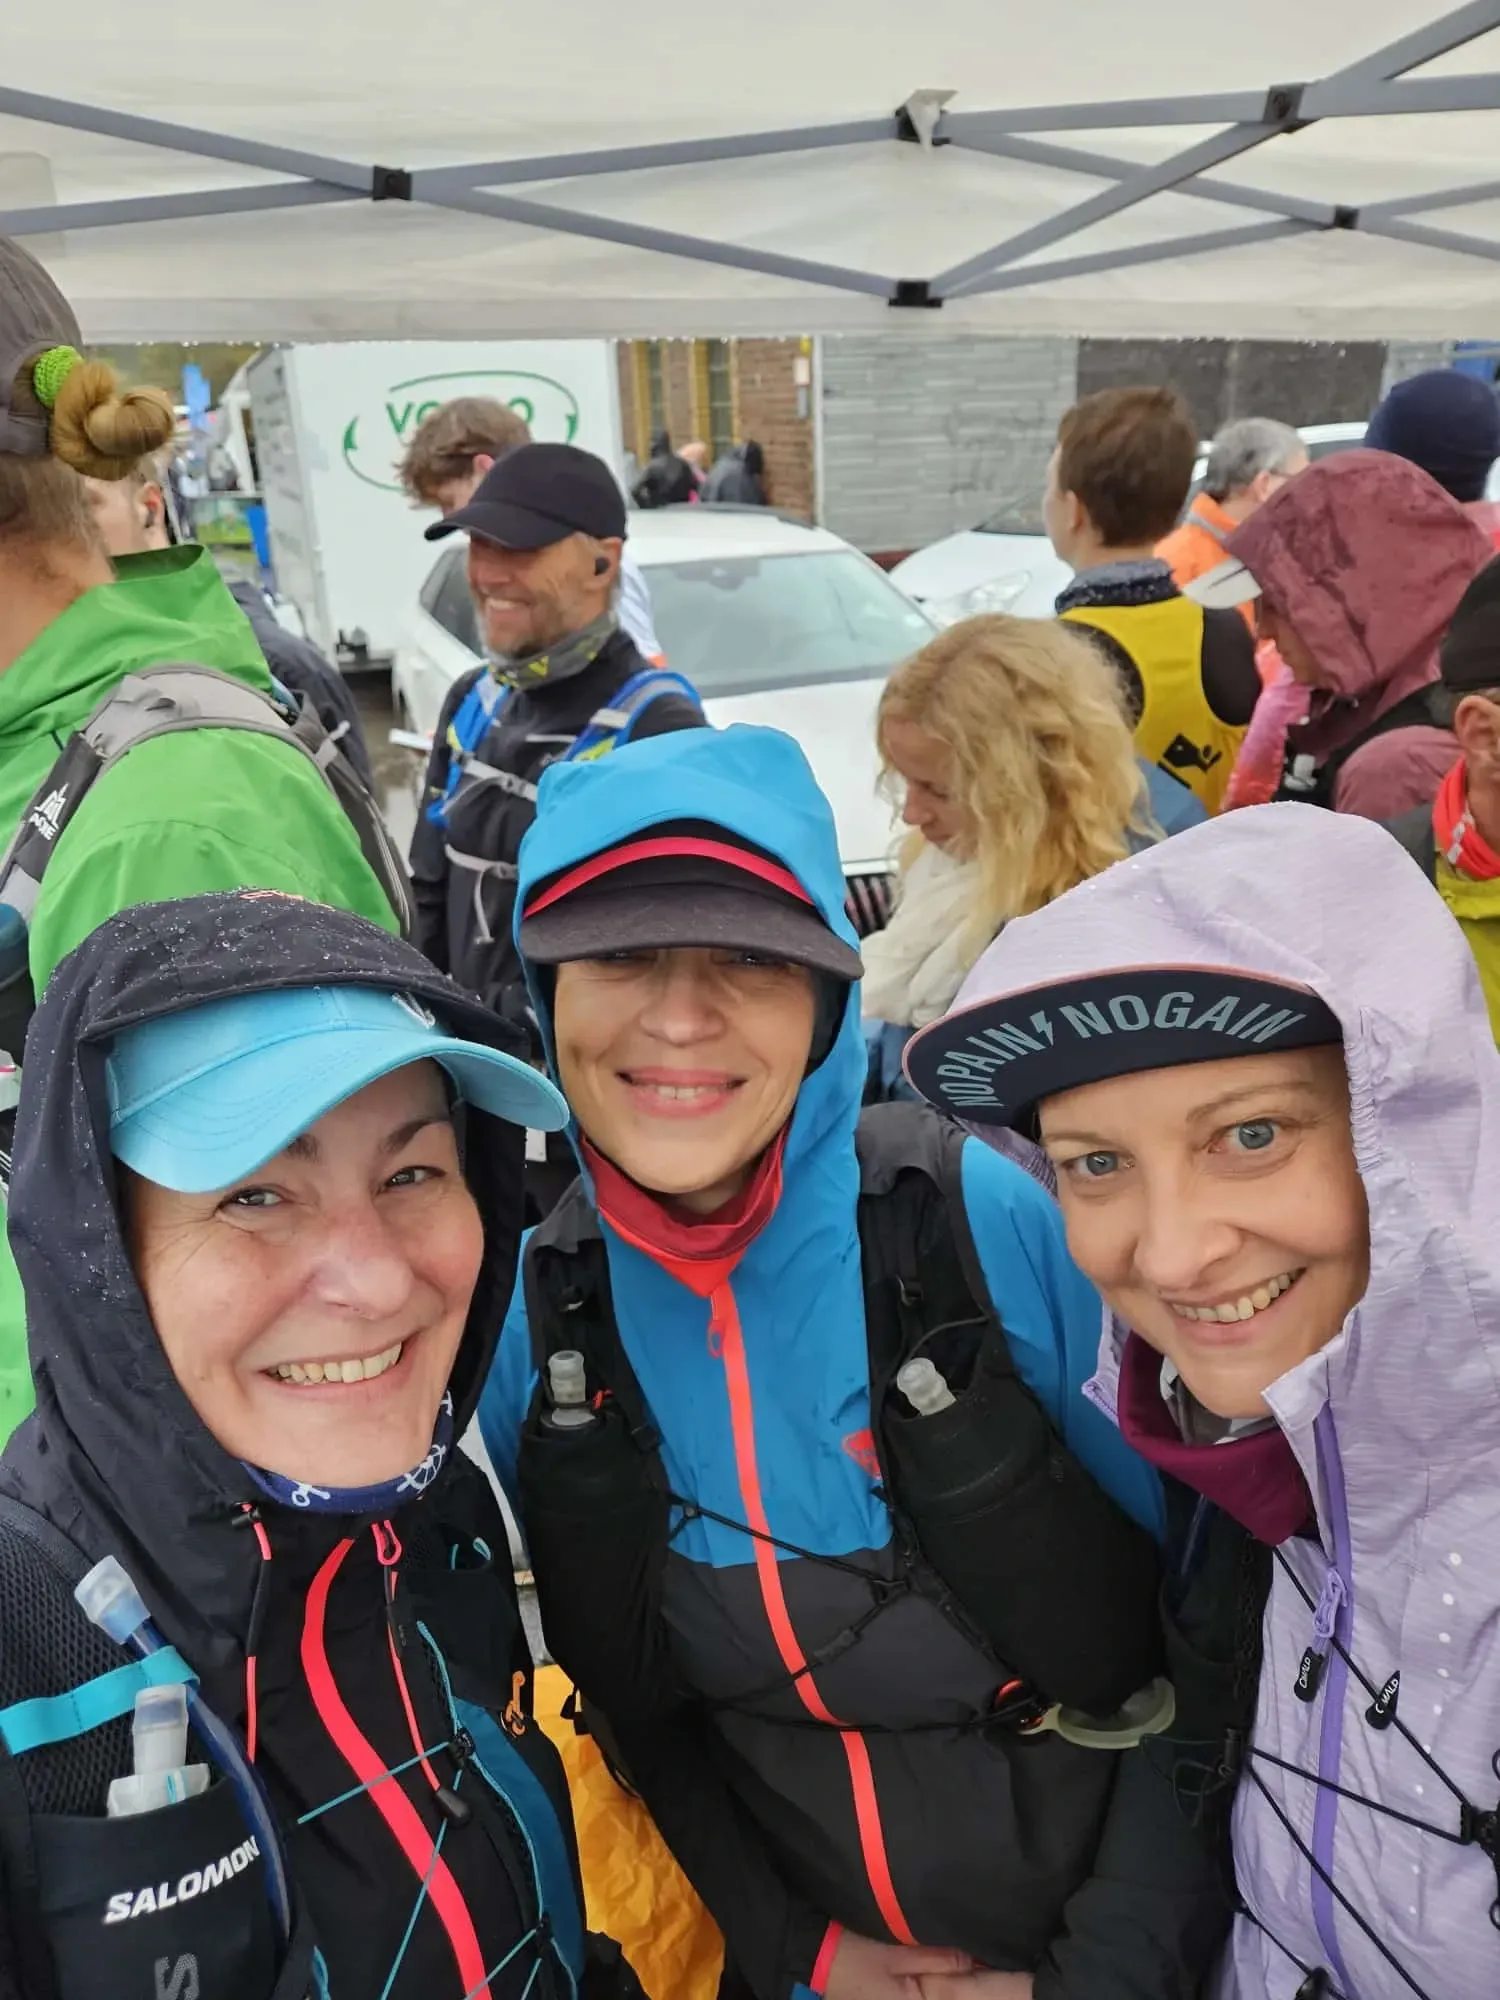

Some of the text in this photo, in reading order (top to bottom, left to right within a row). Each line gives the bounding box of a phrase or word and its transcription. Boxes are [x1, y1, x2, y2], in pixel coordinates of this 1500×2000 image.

[937, 991, 1307, 1107] NOPAIN NOGAIN
[103, 1835, 260, 1925] SALOMON
